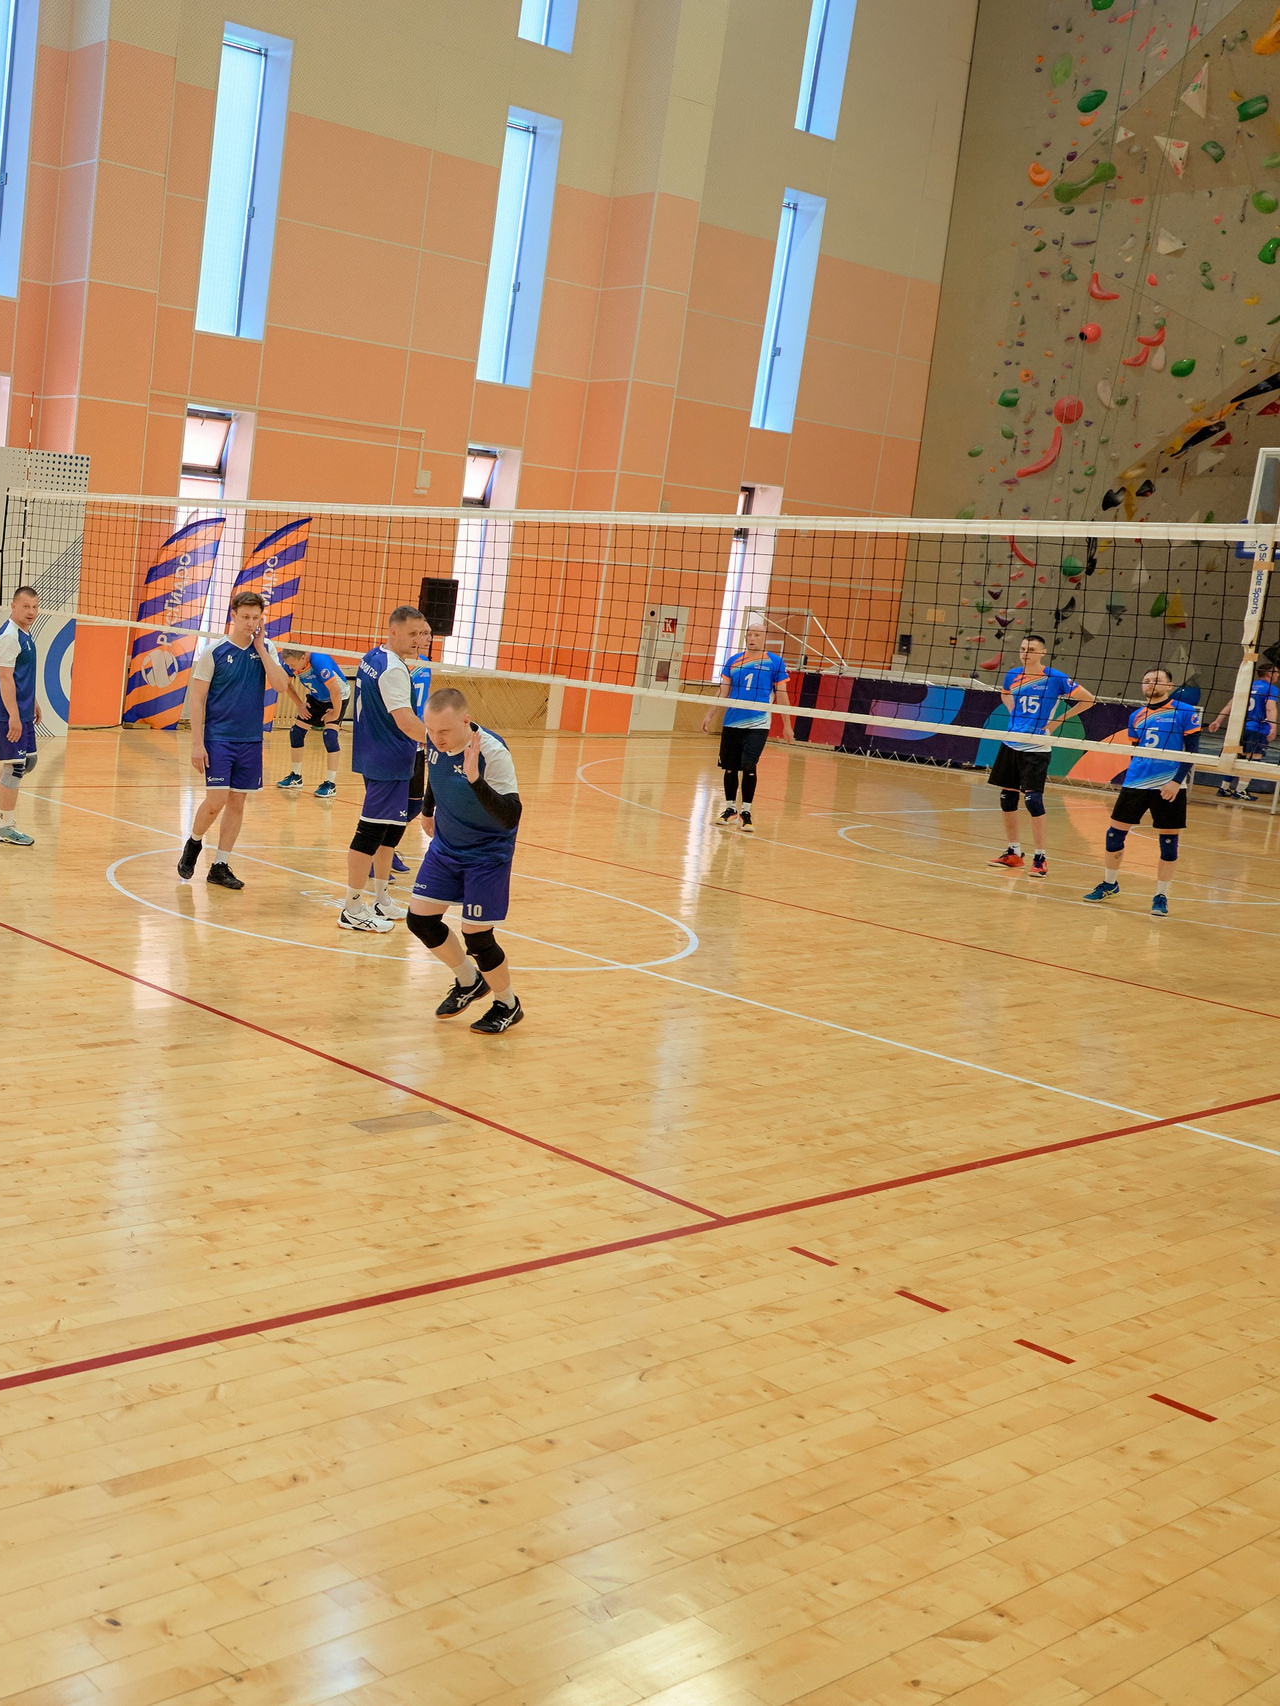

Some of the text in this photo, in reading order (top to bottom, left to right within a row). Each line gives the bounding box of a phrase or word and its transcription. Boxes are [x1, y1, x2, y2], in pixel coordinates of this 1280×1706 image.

[156, 553, 191, 647] РСГИДРО
[1251, 587, 1262, 615] Sports
[226, 654, 234, 664] 4
[744, 673, 754, 691] 1
[1019, 695, 1040, 714] 15
[1145, 727, 1160, 748] 5
[427, 748, 439, 765] 10
[466, 903, 483, 918] 10
